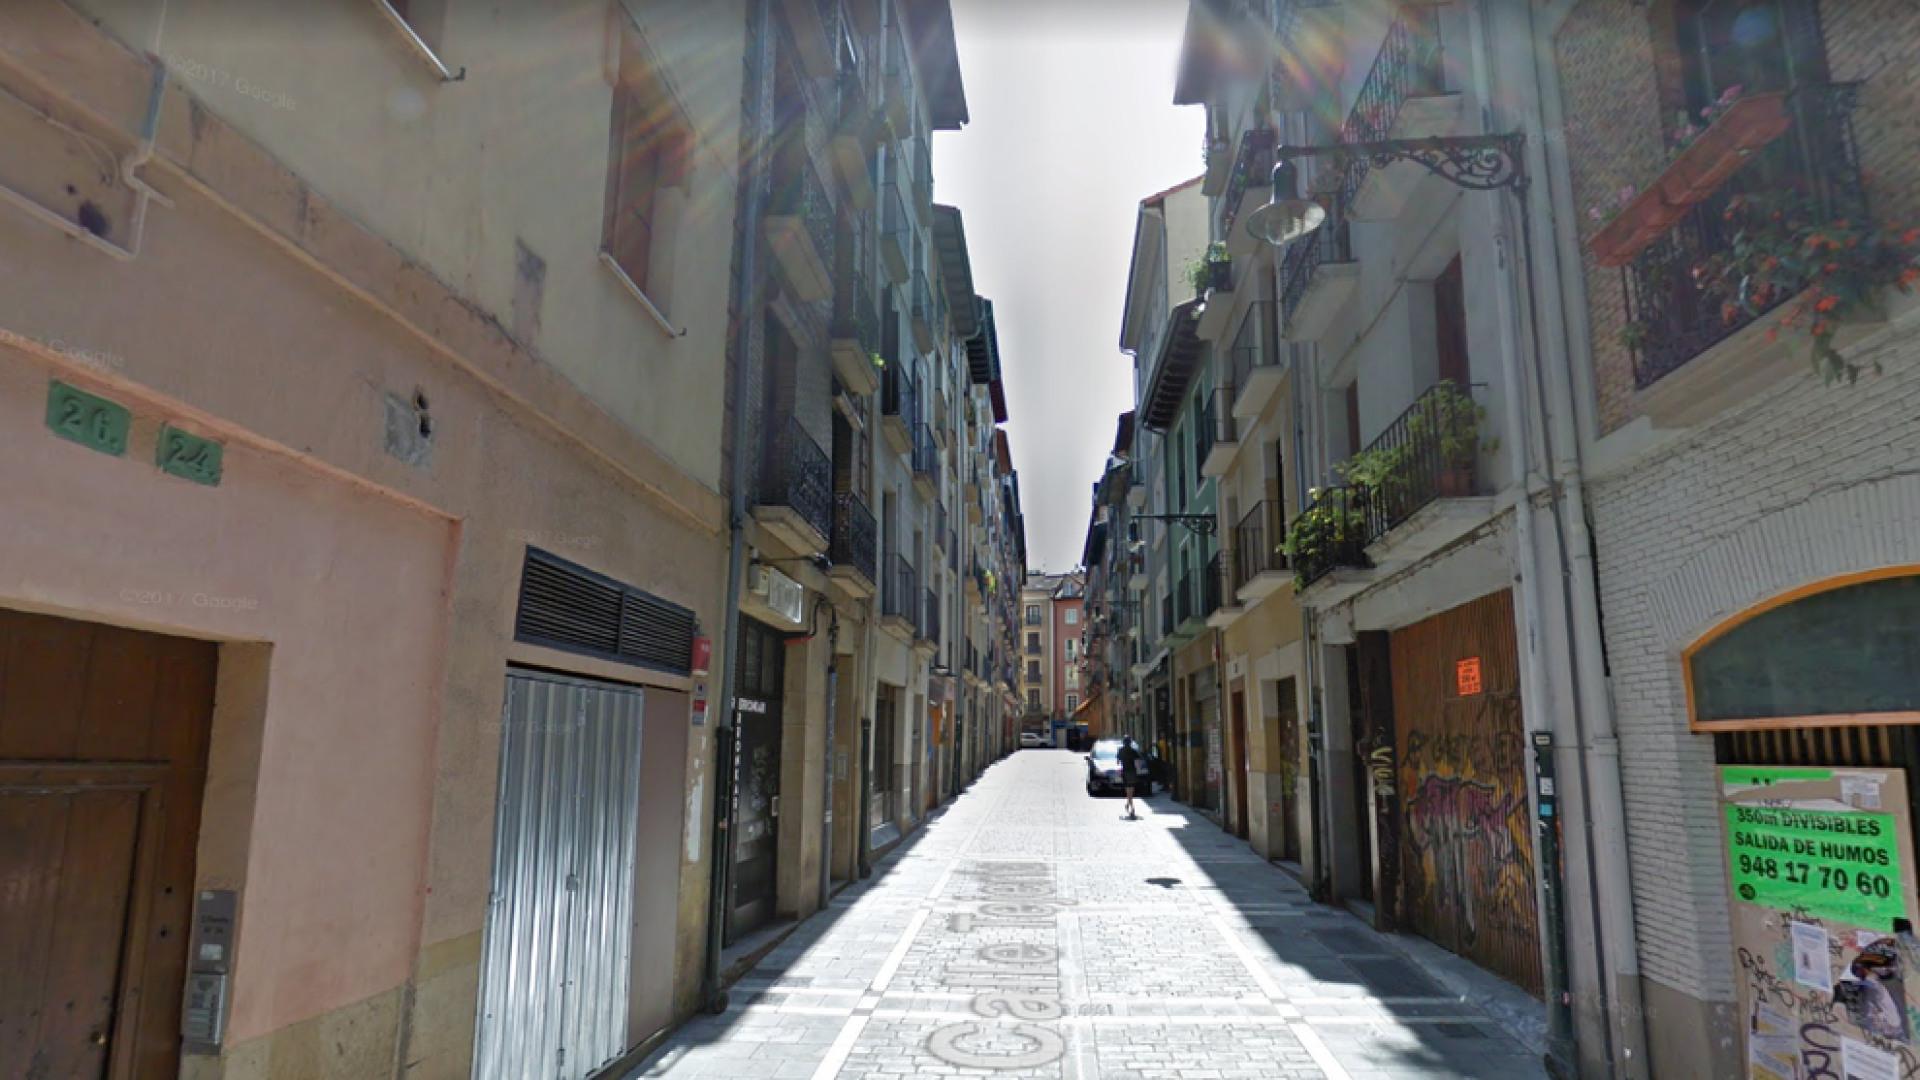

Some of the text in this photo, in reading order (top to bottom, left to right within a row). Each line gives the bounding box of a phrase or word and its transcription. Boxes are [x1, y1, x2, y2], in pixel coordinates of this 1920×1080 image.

[1782, 813, 1881, 836] DIVISIBLES
[1735, 831, 1890, 866] SALIDA DE HUMOS
[1738, 853, 1891, 899] 948 17 70 60
